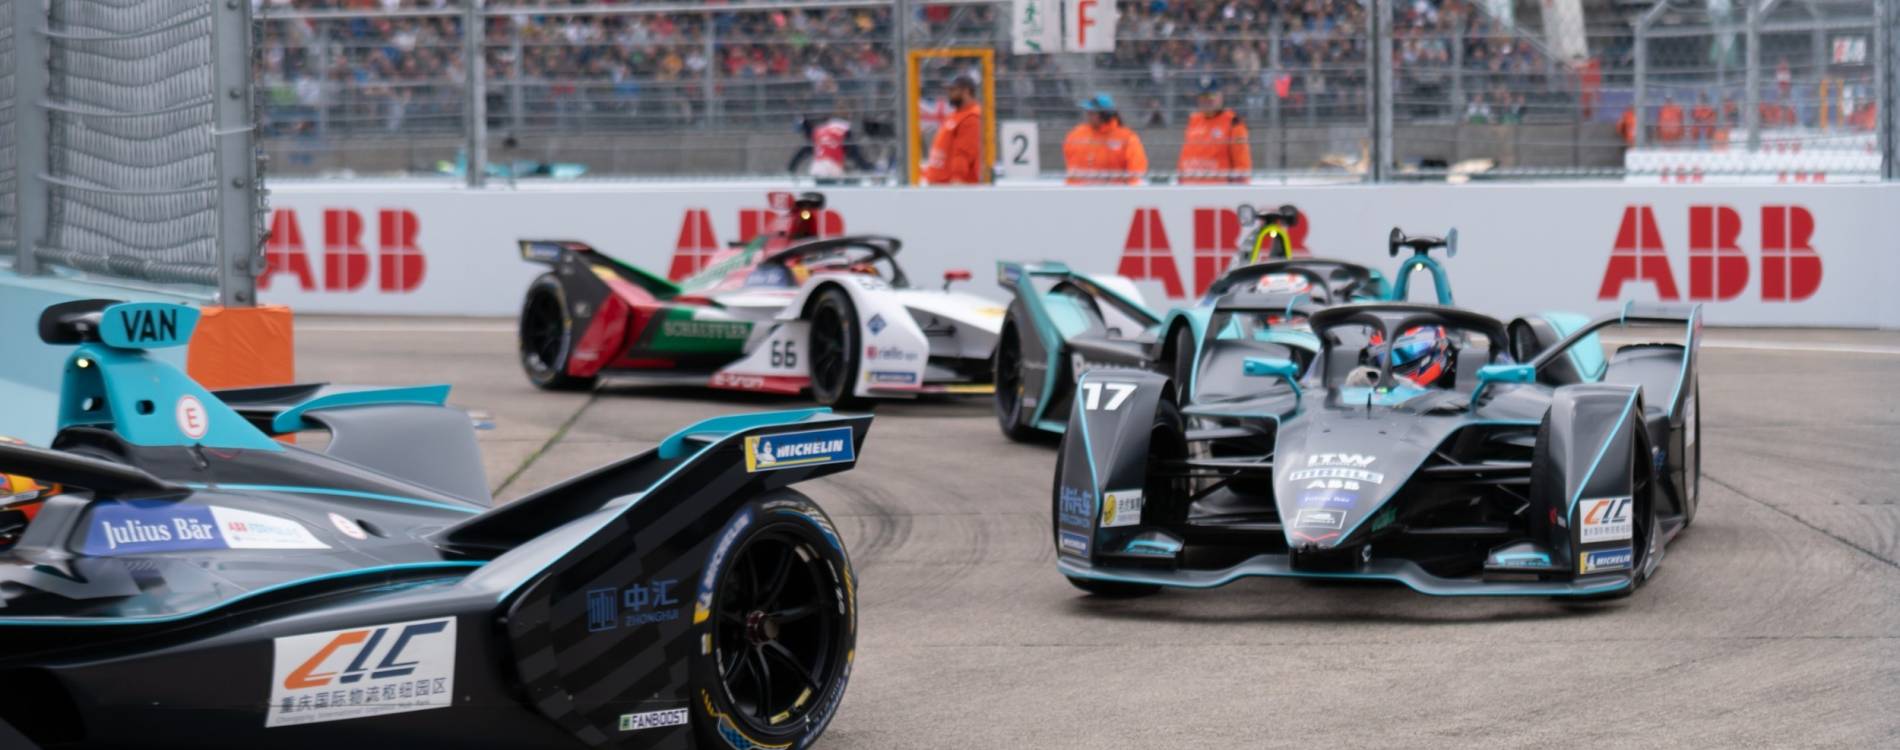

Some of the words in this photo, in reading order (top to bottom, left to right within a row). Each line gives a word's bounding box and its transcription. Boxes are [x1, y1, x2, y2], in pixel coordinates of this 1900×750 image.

[1078, 0, 1099, 48] F
[1012, 134, 1029, 165] 2
[256, 208, 427, 293] ABB
[1597, 205, 1824, 301] ABB
[120, 309, 177, 342] VAN
[770, 340, 797, 368] 66
[1083, 382, 1138, 411] 17
[186, 407, 200, 429] E
[776, 440, 844, 458] MICHELIN
[102, 519, 172, 549] Julius
[173, 517, 214, 541] Bär
[632, 709, 688, 727] FANBOOST
